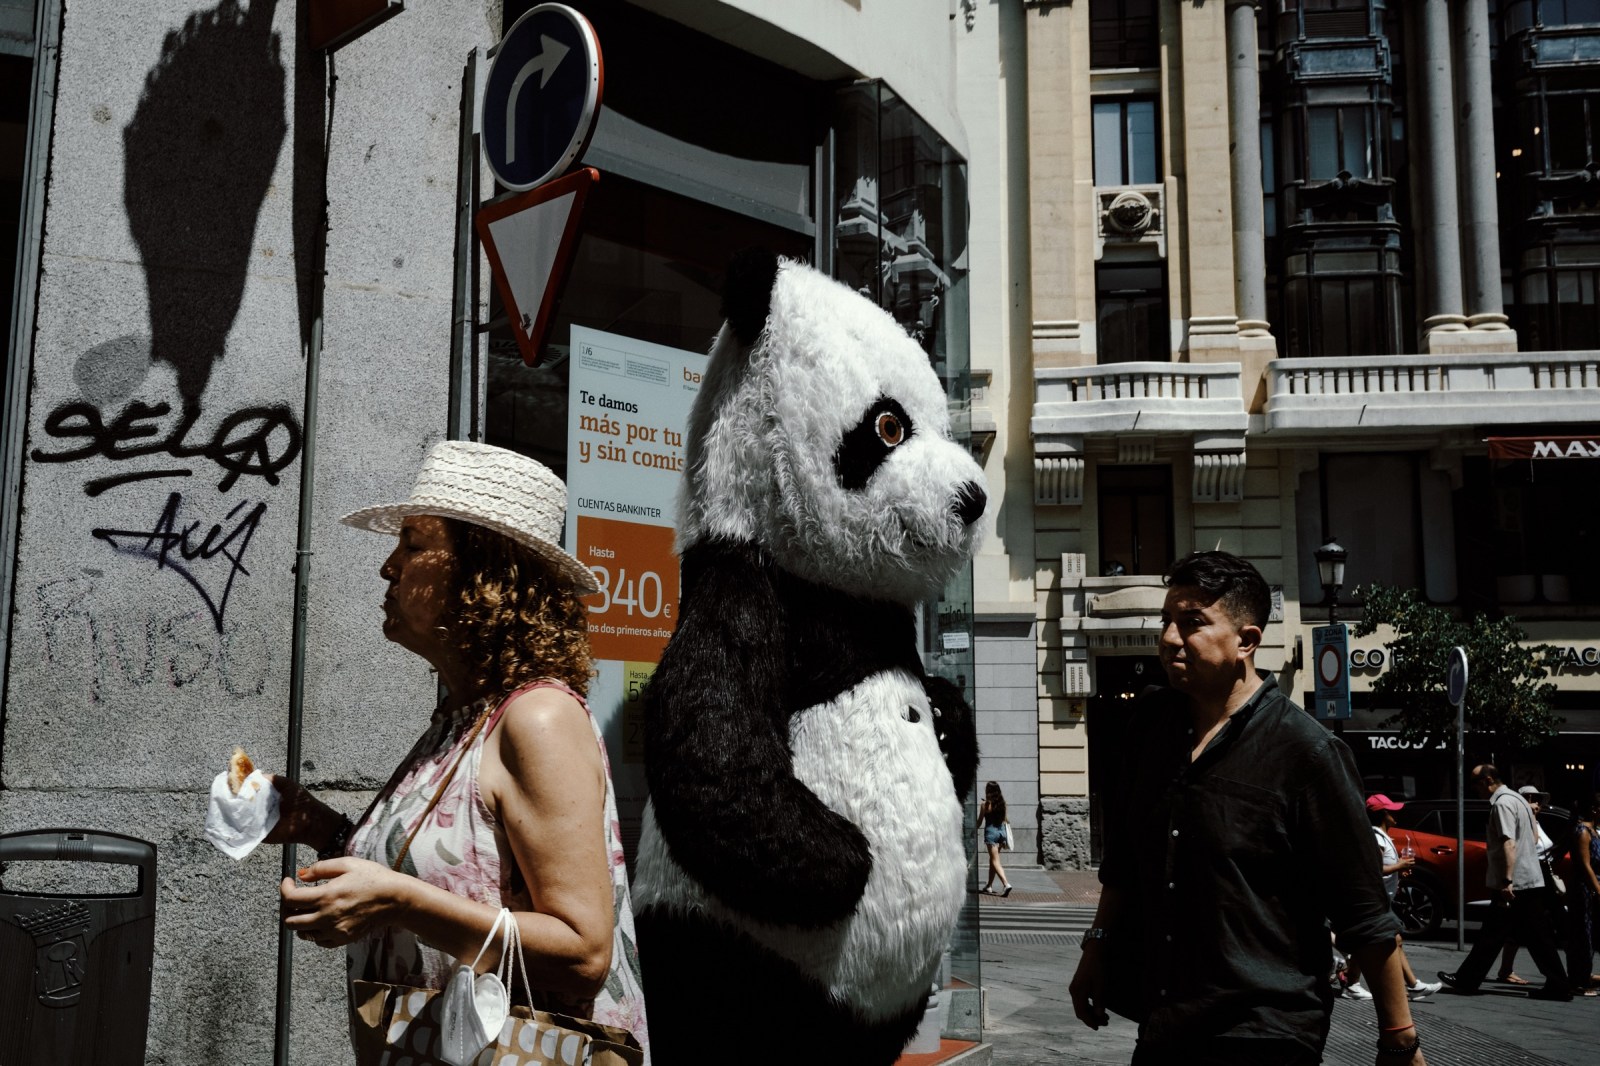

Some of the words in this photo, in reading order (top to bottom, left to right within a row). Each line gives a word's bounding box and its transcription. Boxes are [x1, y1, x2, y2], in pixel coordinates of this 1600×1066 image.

[580, 390, 595, 405] Te
[598, 394, 638, 413] damos
[579, 413, 620, 436] más
[626, 423, 658, 445] por
[663, 427, 682, 447] tu
[579, 441, 591, 463] y
[597, 440, 626, 463] sin
[577, 497, 615, 512] CUENTAS
[616, 503, 661, 518] BANKINTER
[589, 545, 615, 559] Hasta
[587, 622, 599, 633] los
[601, 623, 615, 634] dos
[616, 625, 652, 637] primeros
[653, 627, 672, 638] años
[1368, 736, 1410, 750] TACO
